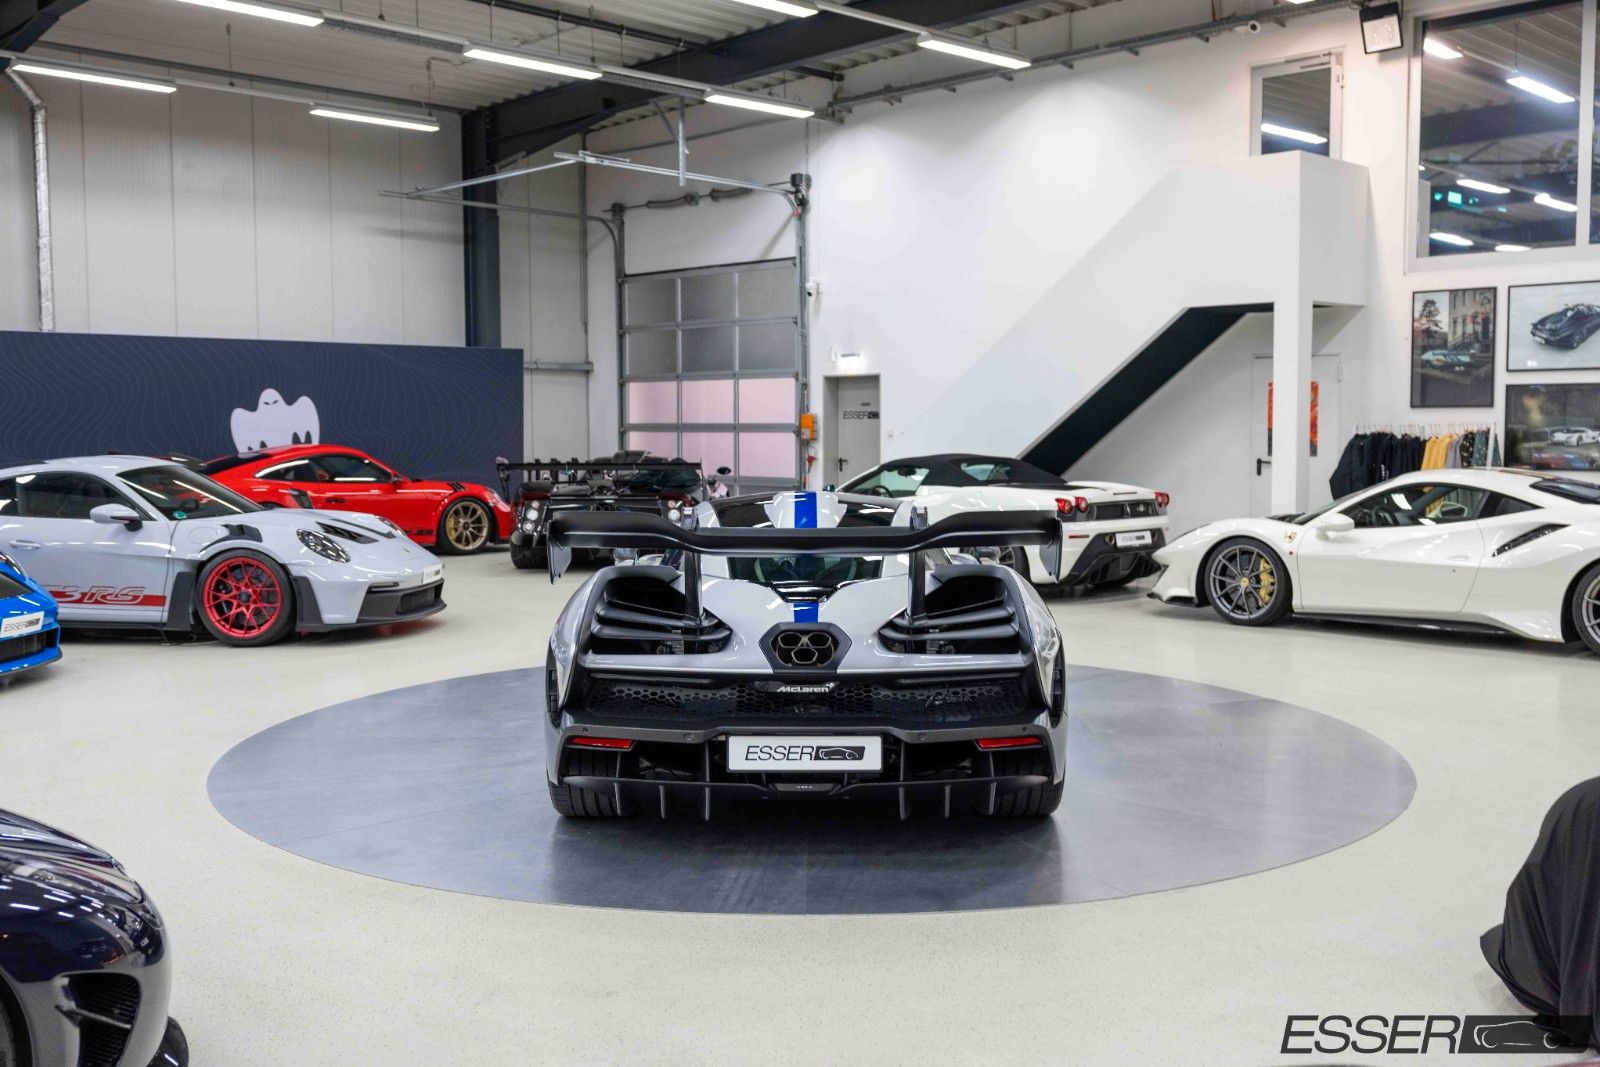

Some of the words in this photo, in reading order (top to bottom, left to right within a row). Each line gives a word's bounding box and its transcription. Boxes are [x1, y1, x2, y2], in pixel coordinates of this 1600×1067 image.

[842, 410, 868, 420] ESSER
[83, 584, 146, 605] RS
[745, 745, 815, 761] ESSER
